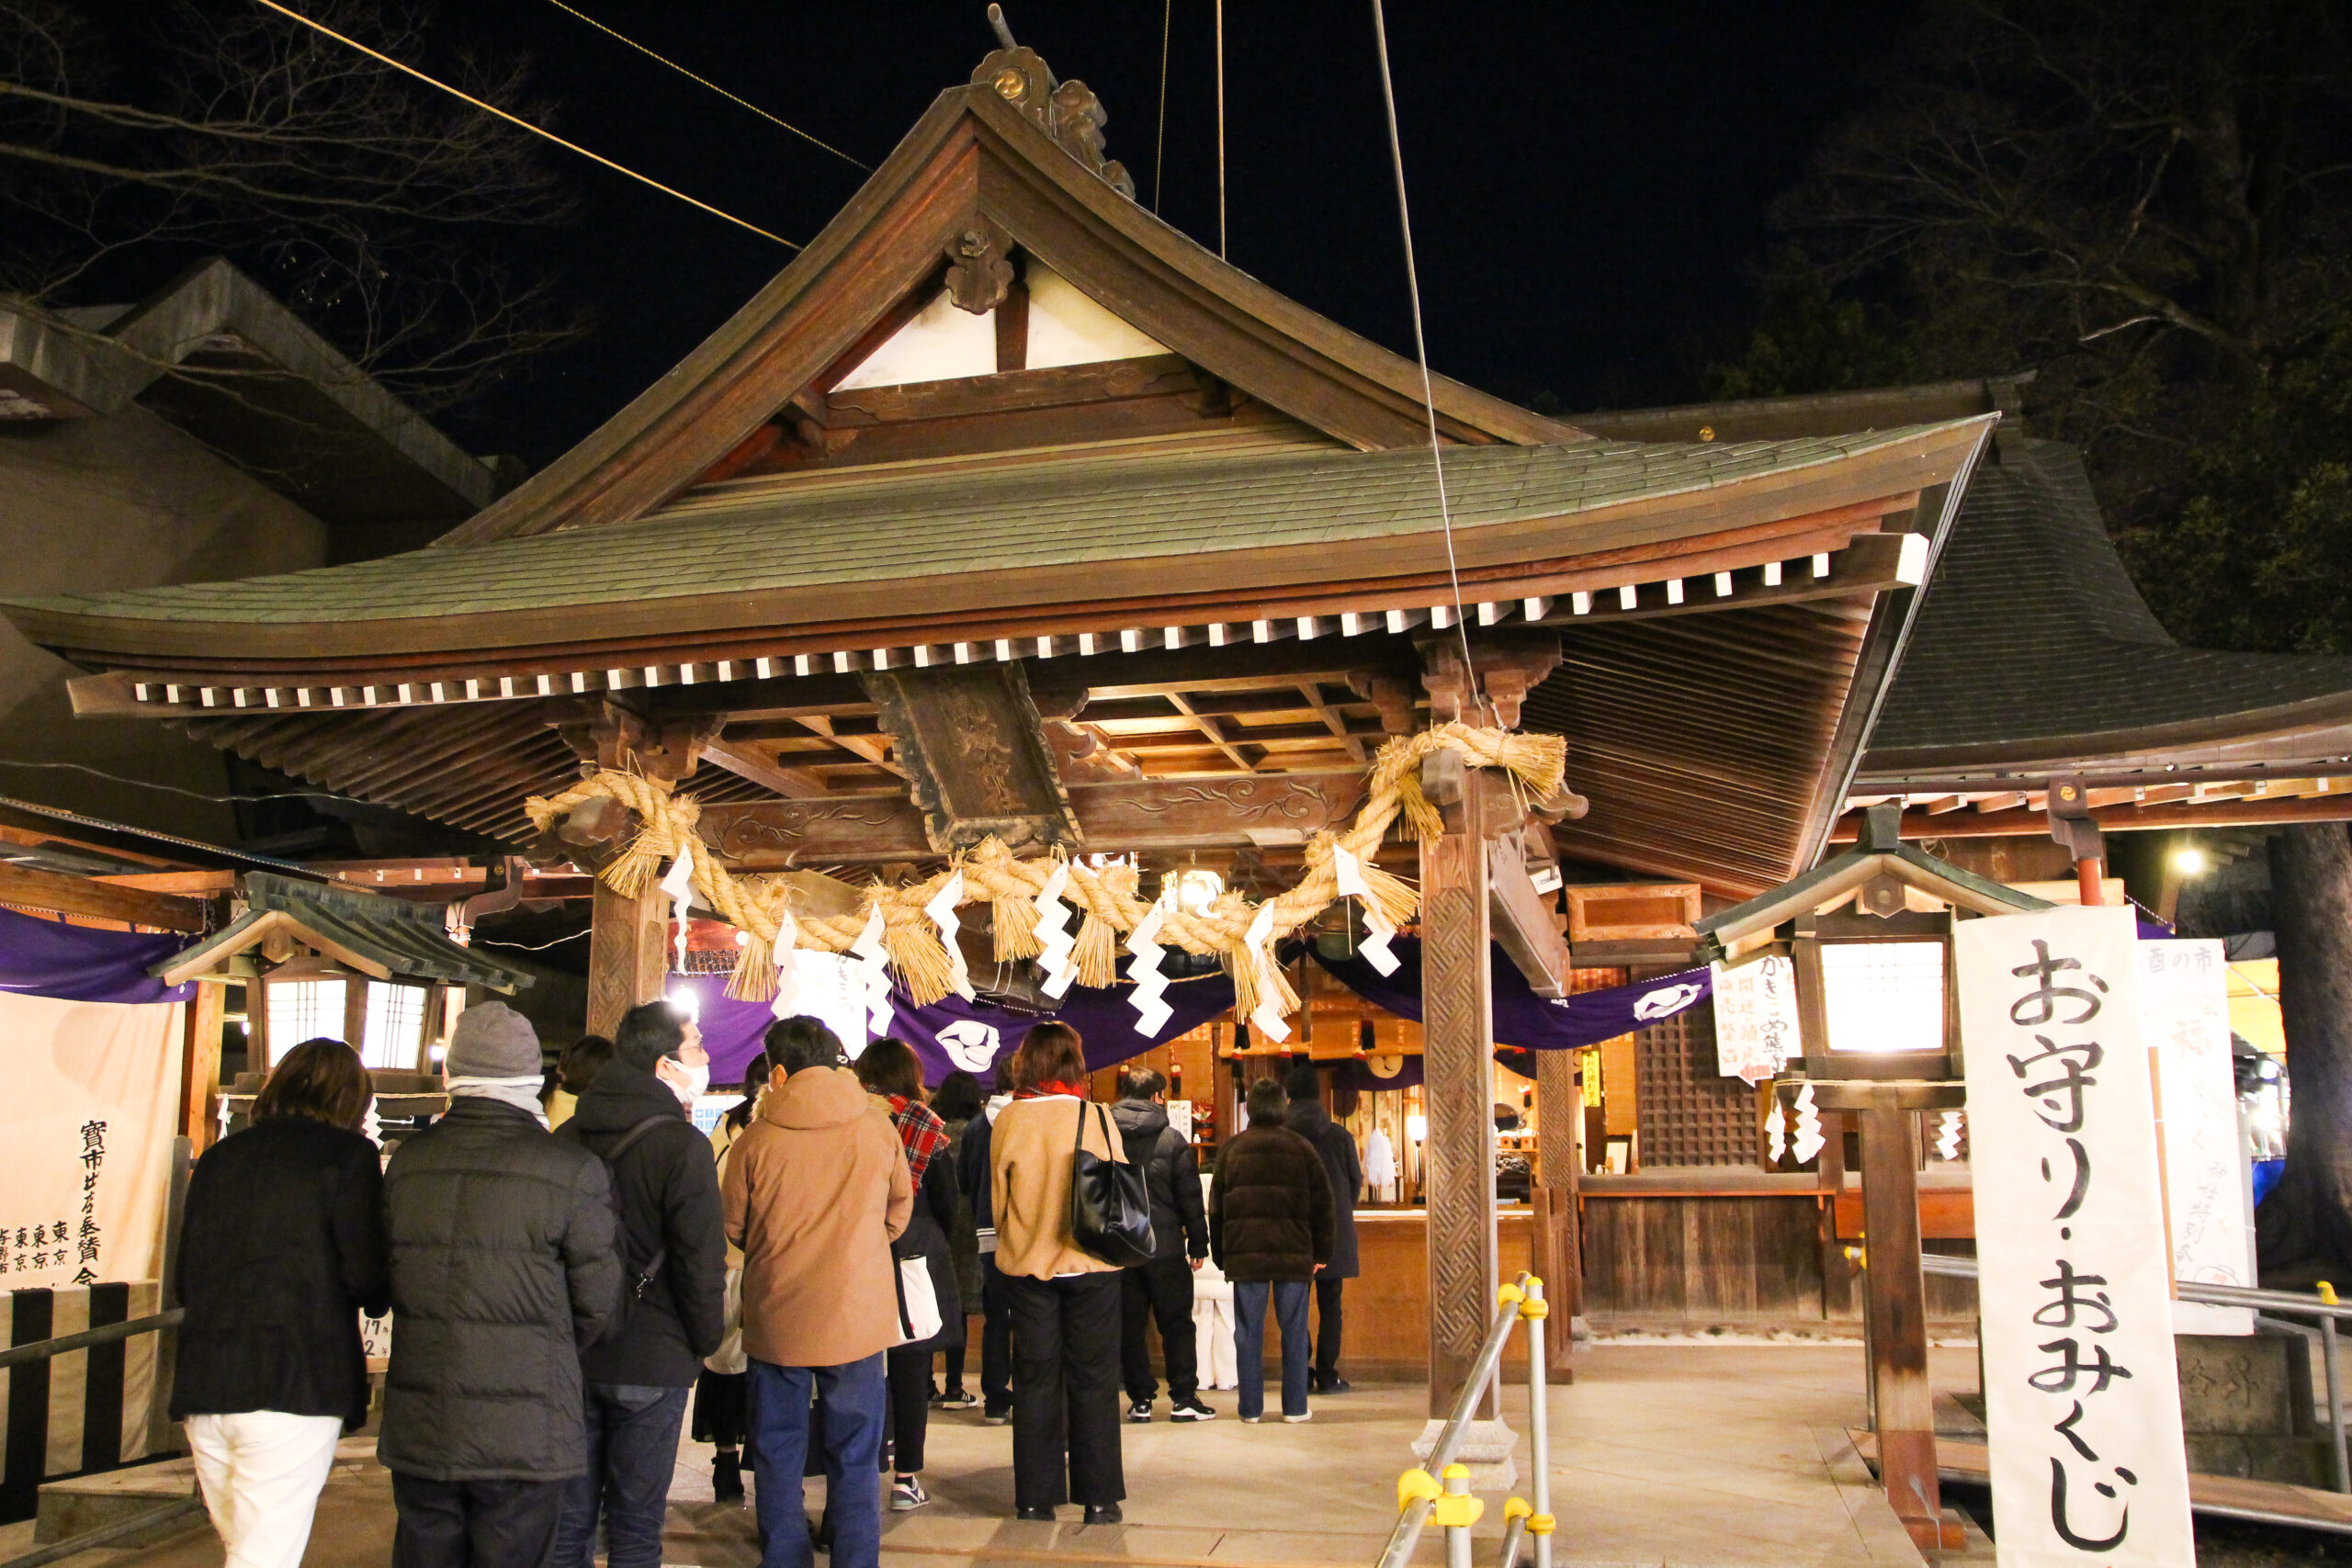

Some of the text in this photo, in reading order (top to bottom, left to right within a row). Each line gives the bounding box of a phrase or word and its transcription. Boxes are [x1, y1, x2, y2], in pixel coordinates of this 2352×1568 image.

[2007, 939, 2138, 1552] お守り・おみくじ
